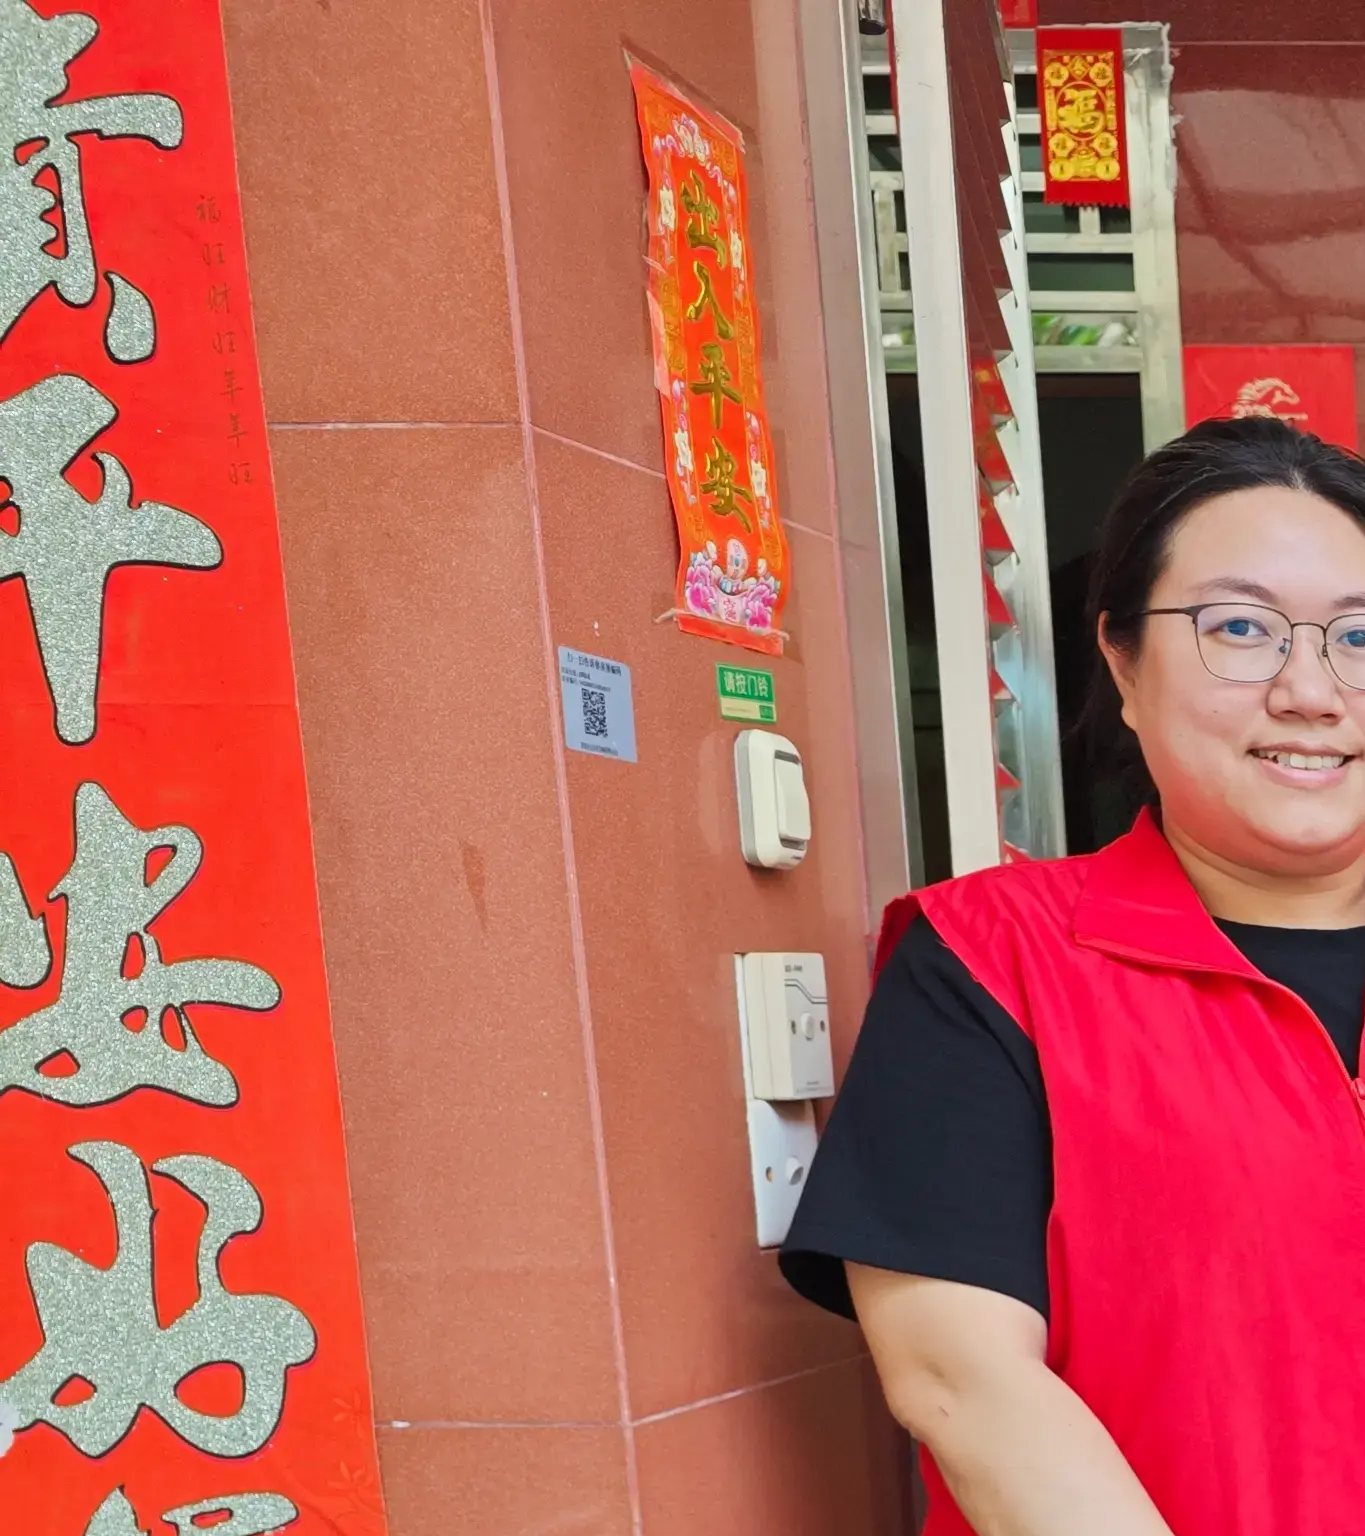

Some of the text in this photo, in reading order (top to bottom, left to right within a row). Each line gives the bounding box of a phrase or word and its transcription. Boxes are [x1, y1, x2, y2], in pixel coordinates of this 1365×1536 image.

[680, 168, 754, 534] 出入平安
[723, 670, 769, 698] 请按门铃
